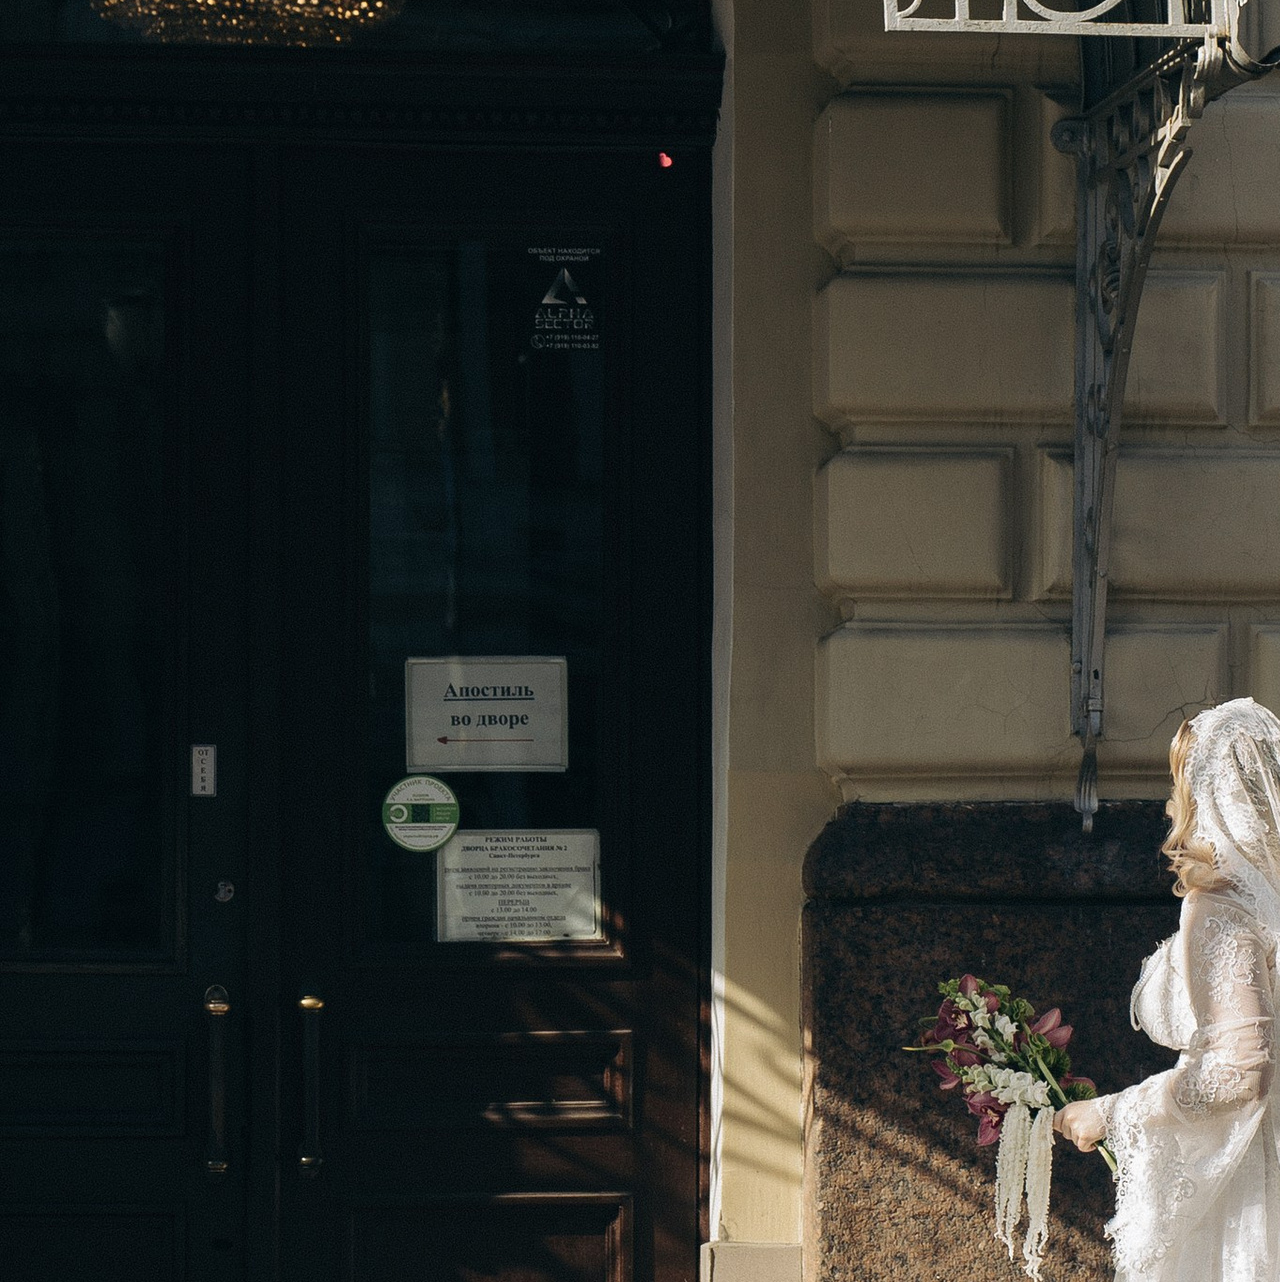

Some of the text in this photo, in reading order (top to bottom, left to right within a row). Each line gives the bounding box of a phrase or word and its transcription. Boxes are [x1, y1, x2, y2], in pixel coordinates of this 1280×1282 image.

[534, 308, 594, 319] ALPHA
[534, 319, 594, 329] SECTOR
[443, 682, 535, 699] Апостиль
[451, 714, 529, 729] во дворе
[390, 779, 452, 802] УЧАСТНИК ПРОЕКТА
